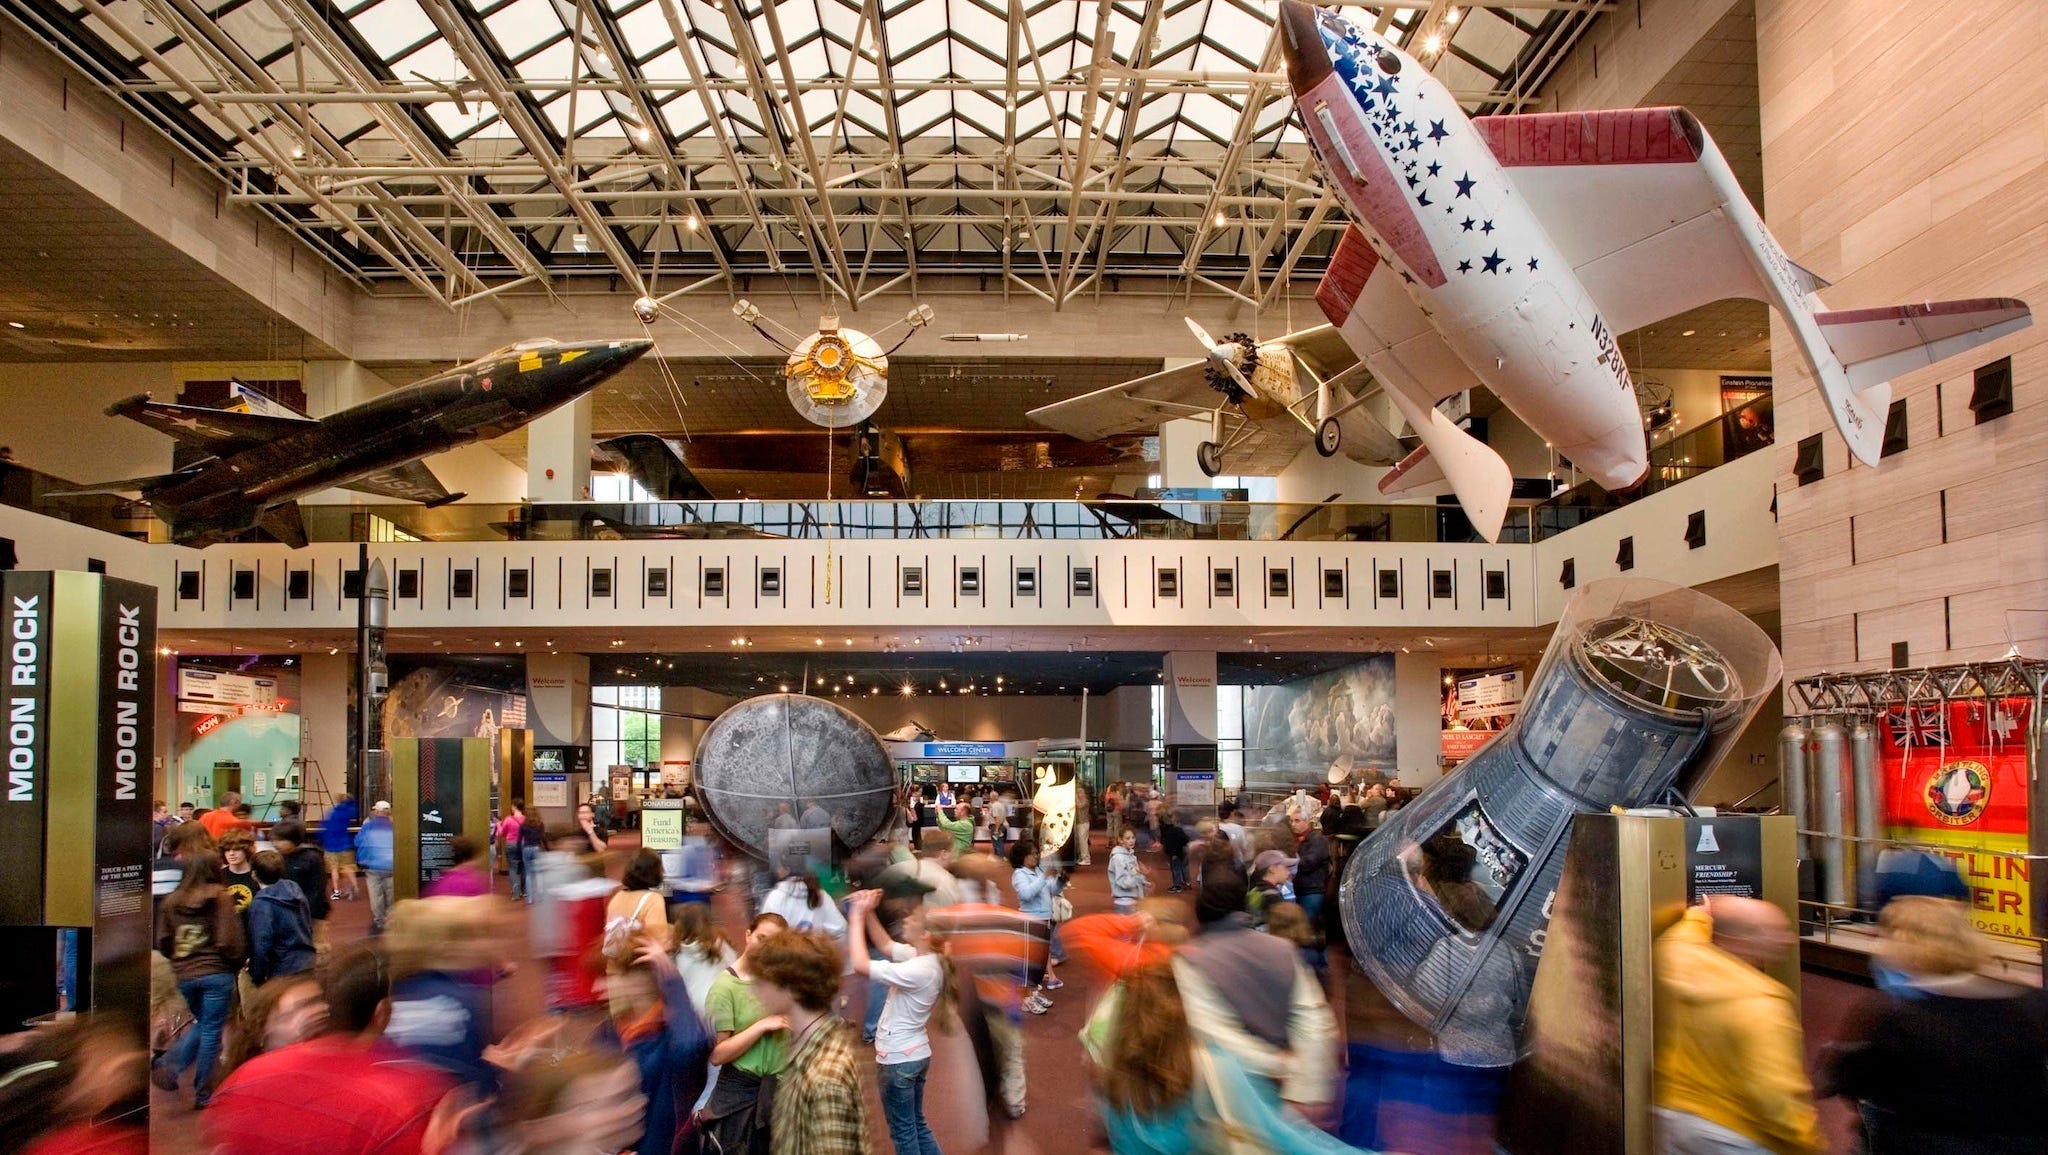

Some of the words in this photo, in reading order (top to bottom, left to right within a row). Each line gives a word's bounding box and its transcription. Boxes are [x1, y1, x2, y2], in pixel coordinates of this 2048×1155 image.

[1591, 313, 1630, 391] N328KF
[11, 595, 39, 686] ROCK
[118, 603, 140, 691] ROCK
[532, 676, 566, 685] Welcome
[1177, 676, 1211, 684] Welcome
[196, 715, 220, 735] HOW
[8, 697, 36, 802] MOON
[115, 701, 138, 801] MOON
[642, 800, 681, 808] DONATIONS
[1928, 804, 1976, 825] ORBITER
[652, 817, 672, 826] Fund
[645, 826, 681, 835] America's
[646, 835, 679, 843] Treasures
[101, 866, 121, 874] TOUCH
[110, 872, 121, 880] THE
